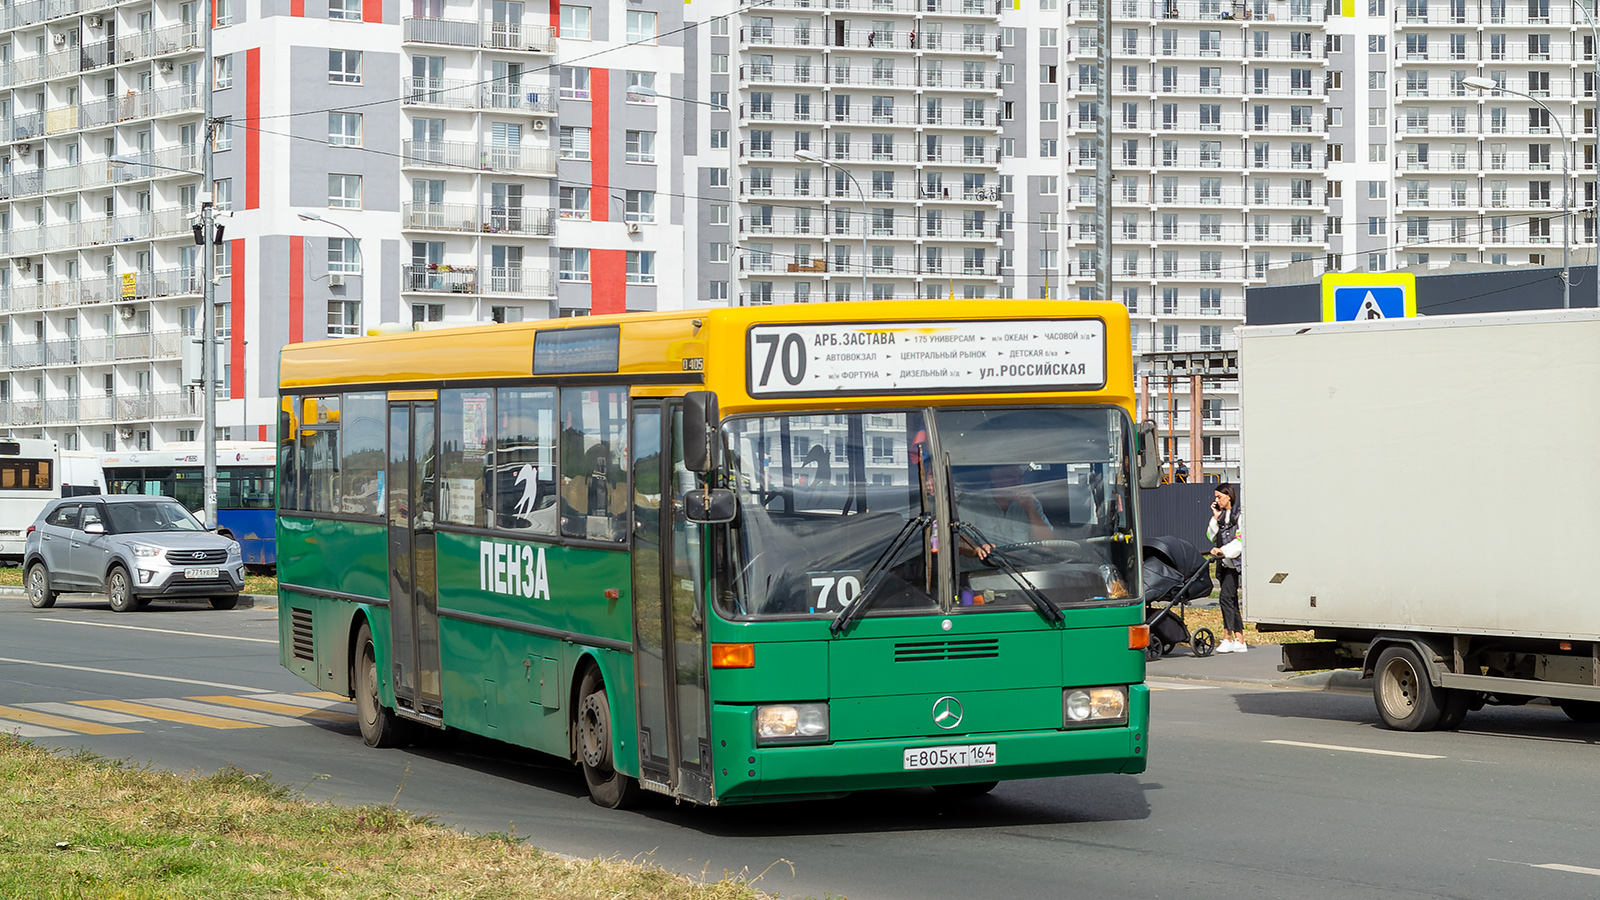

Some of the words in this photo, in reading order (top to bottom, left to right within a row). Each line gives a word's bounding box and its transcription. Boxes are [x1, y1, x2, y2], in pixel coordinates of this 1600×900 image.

[814, 332, 896, 346] АРБ.ЗАСТАВА
[929, 334, 975, 343] УНИВЕРСАМ
[1044, 332, 1079, 340] ЧАСОВОЙ
[689, 358, 703, 370] 405
[755, 332, 807, 387] 70
[826, 353, 877, 362] АВТОВОКЗАЛ
[900, 350, 958, 360] ЦЕНТРАЛЬНЫЙ
[959, 350, 987, 359] РЫНОК
[1009, 349, 1043, 358] ДЕТСКАЯ
[841, 370, 879, 379] ФОРТУНА
[899, 367, 948, 379] ДИЗЕЛЬНЫЙ
[979, 360, 1086, 380] ул.РОССИЙСКАЯ
[480, 541, 550, 600] ПЕНЗА
[811, 575, 861, 609] 70
[910, 749, 967, 767] Е805КТ
[970, 746, 992, 759] 164
